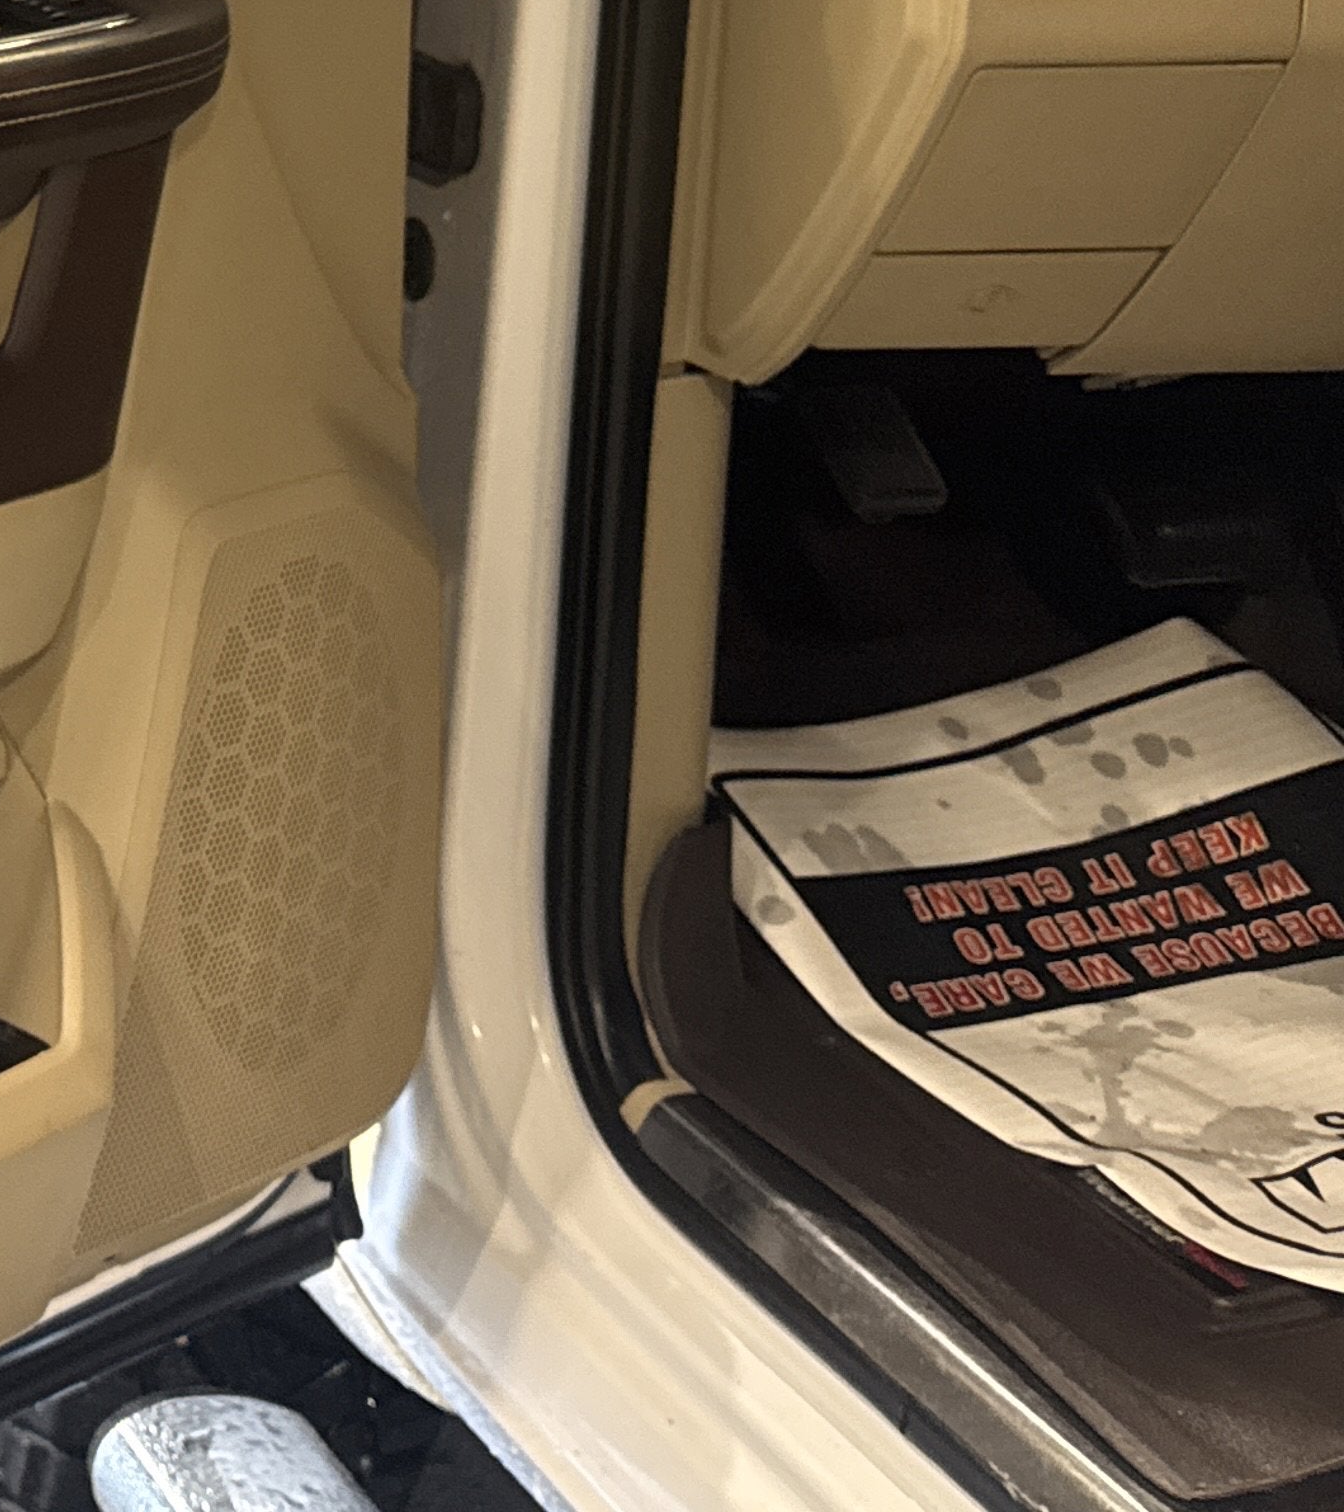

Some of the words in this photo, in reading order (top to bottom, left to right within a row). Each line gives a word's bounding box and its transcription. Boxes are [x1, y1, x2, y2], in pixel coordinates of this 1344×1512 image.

[1146, 810, 1271, 879] KEEP
[903, 865, 1074, 924] CLEAN!
[1081, 851, 1137, 896] IT
[1224, 859, 1311, 911] WE
[1026, 882, 1228, 953] WANTED
[1130, 901, 1344, 979] BECAUSE
[952, 923, 1025, 965] TO
[889, 968, 1046, 1019] CARE,
[1047, 952, 1134, 992] WE
